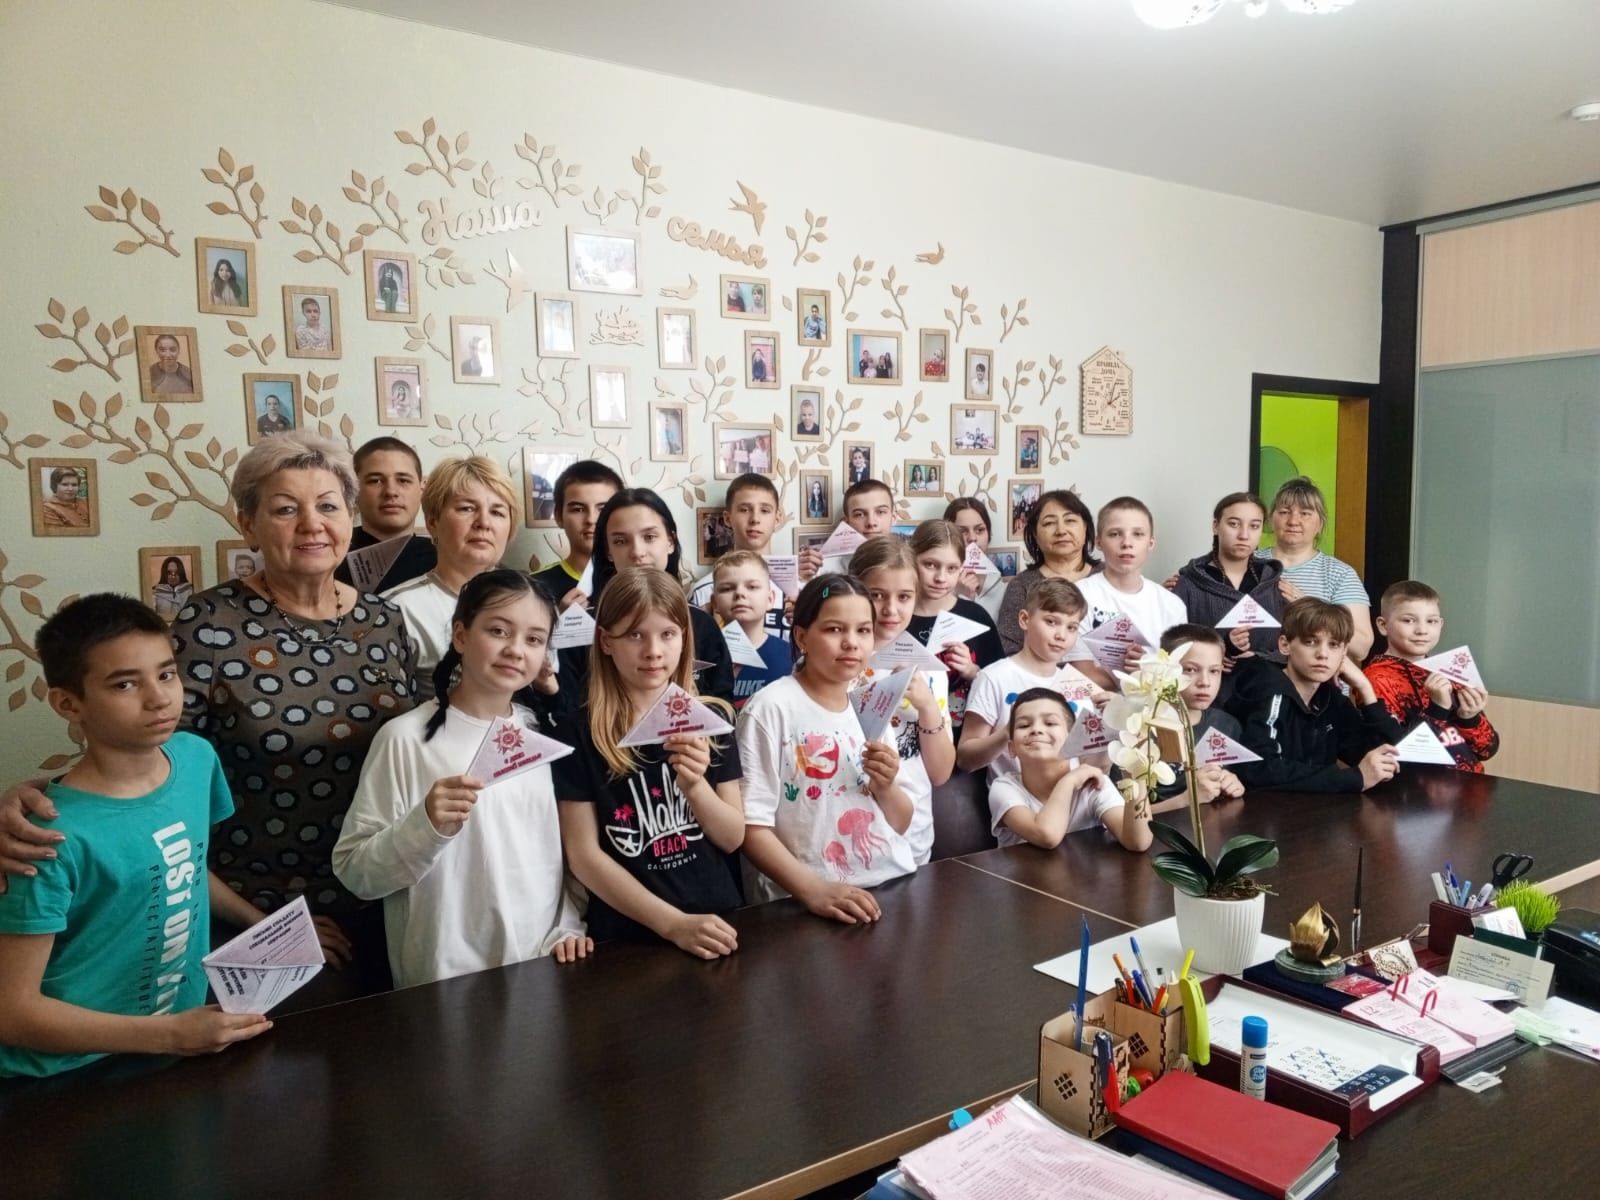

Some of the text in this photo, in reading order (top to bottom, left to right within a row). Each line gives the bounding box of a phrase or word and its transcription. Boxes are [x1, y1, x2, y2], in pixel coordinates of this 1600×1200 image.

[418, 197, 544, 246] Наша
[152, 821, 195, 906] LOST
[647, 852, 697, 870] CALIFORNIA
[653, 834, 688, 857] BEACH
